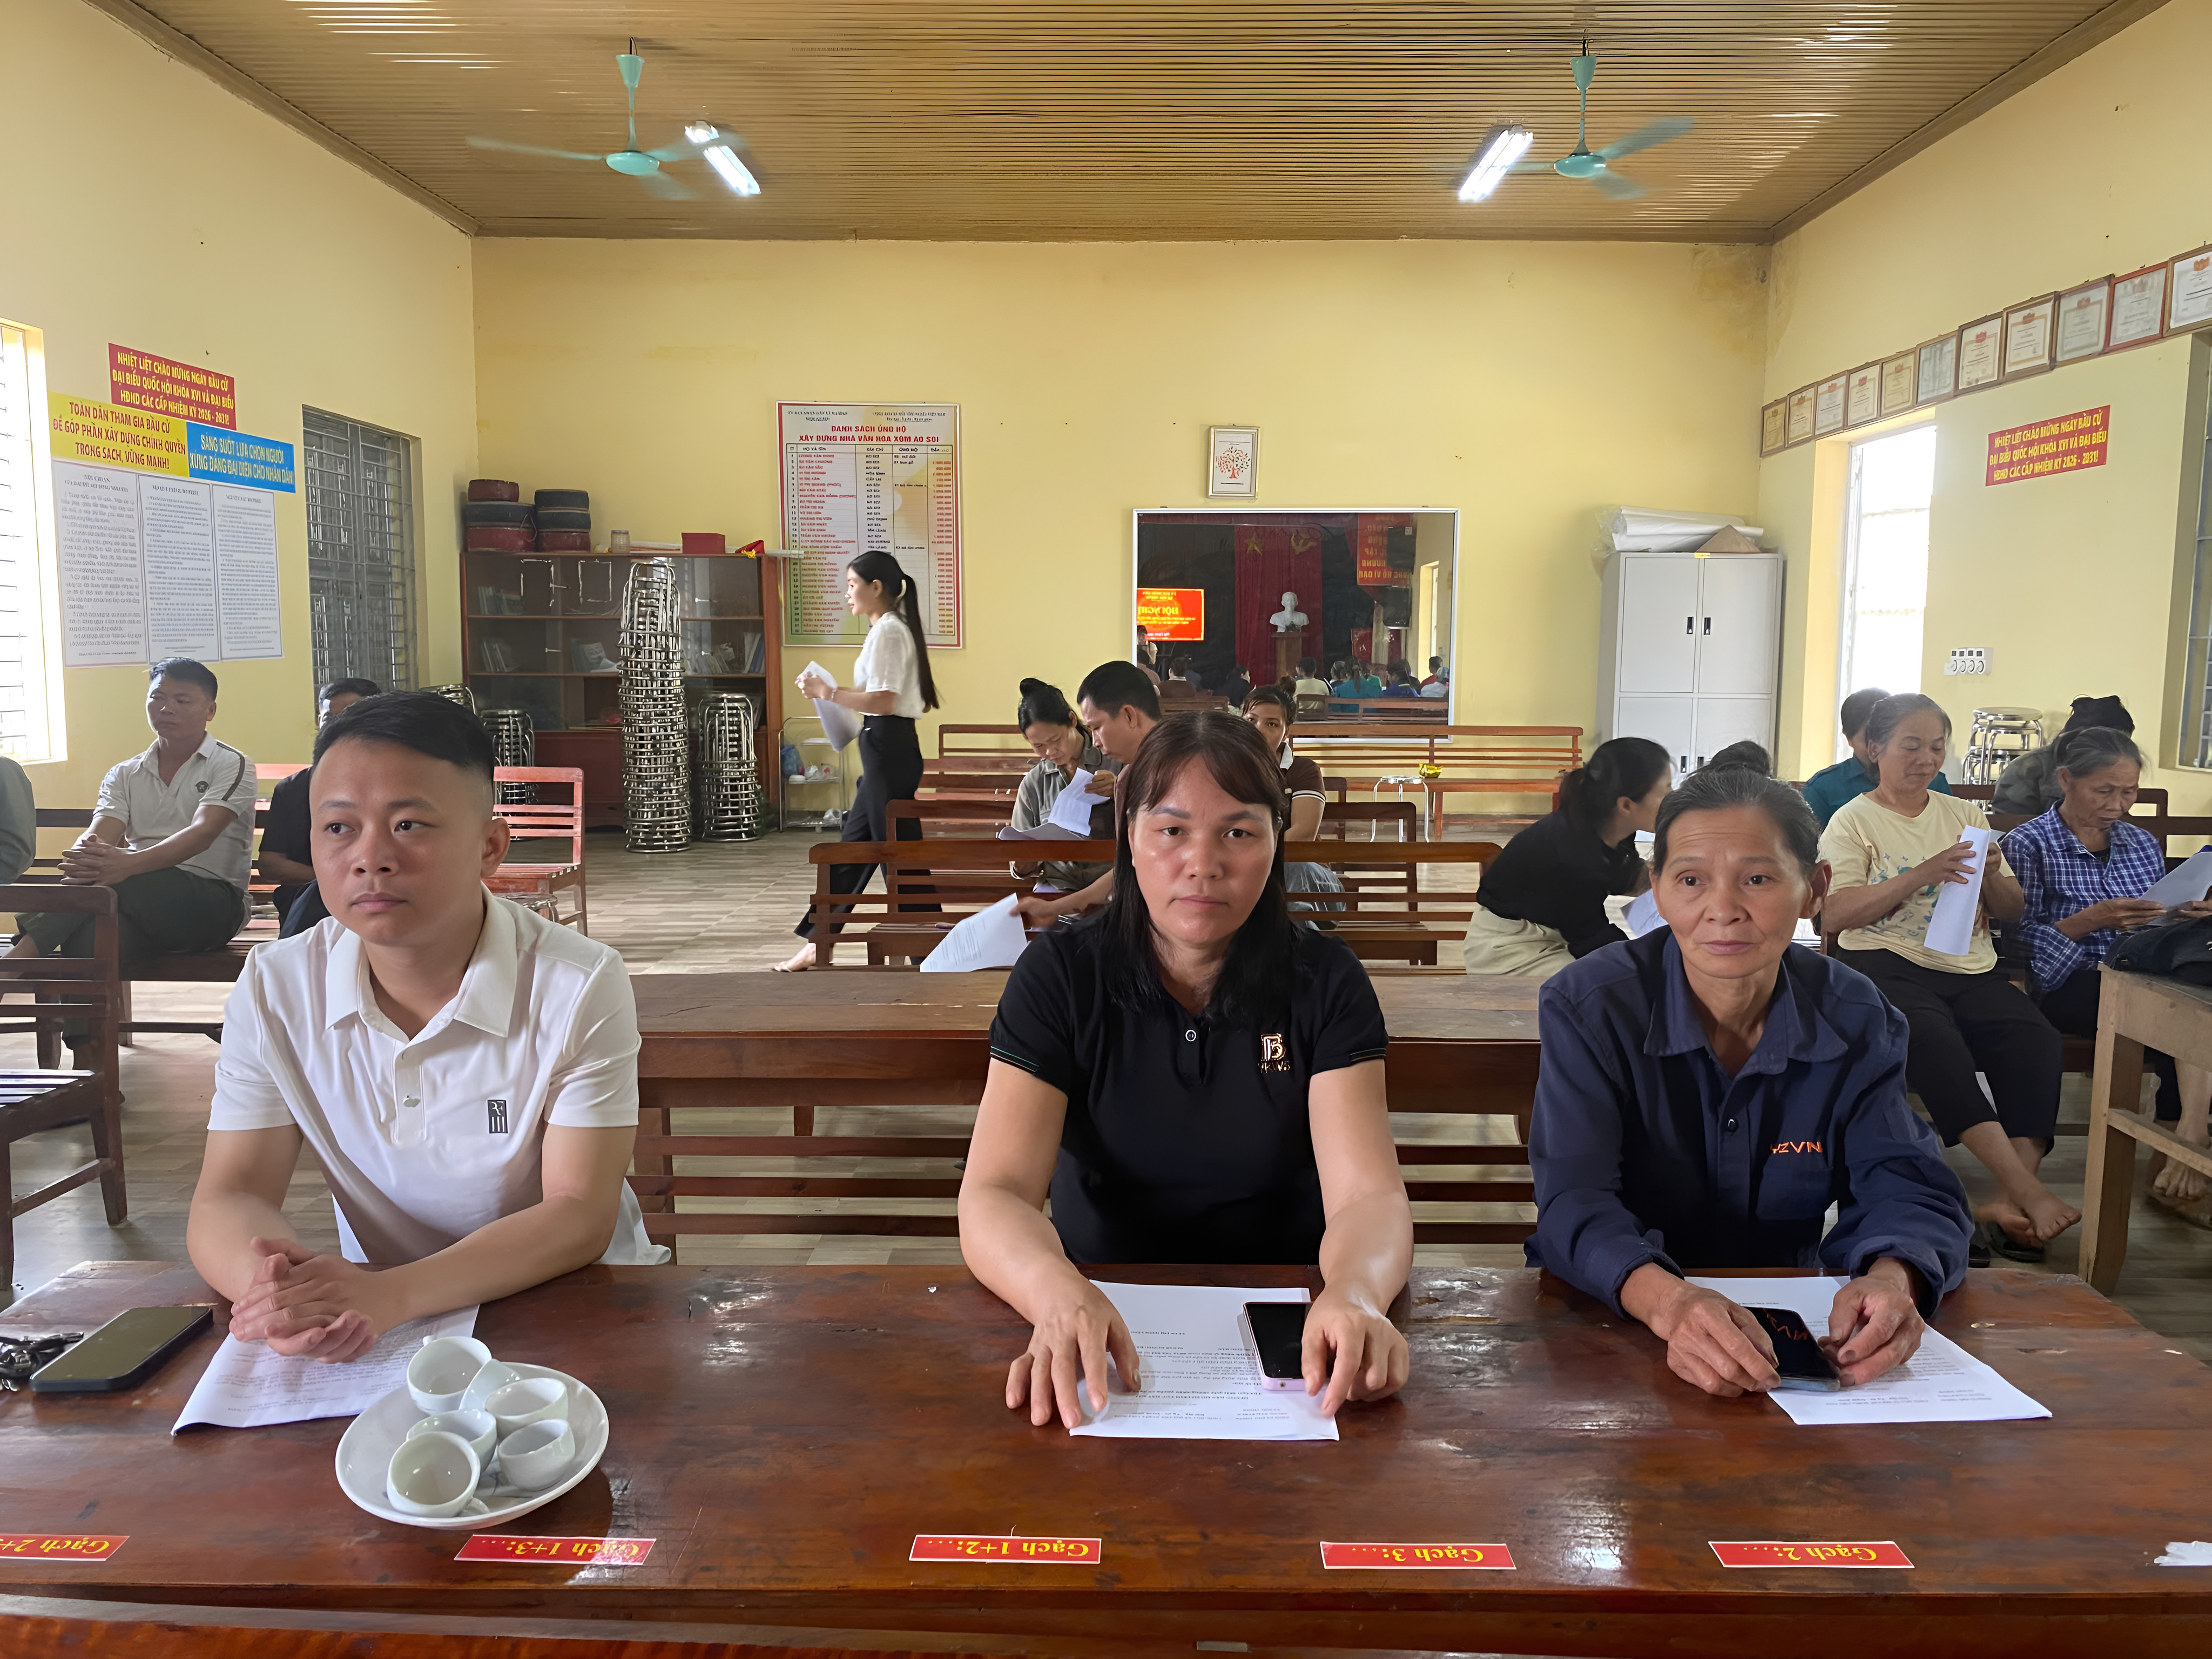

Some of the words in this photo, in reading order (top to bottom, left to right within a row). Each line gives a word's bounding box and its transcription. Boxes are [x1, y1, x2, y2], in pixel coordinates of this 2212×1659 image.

[118, 352, 137, 370] NHIỆT
[139, 356, 152, 374] LIỆT
[172, 365, 190, 382] MỪNG
[191, 370, 206, 387] NGÀY
[208, 373, 219, 391] BẦU
[221, 376, 228, 391] CỬ
[112, 369, 124, 386] ĐẠI
[143, 376, 160, 390] QUỐC
[161, 379, 172, 396] HỘI
[191, 389, 200, 401] XVI
[202, 390, 210, 404] VÀ
[211, 394, 221, 409] ĐẠI
[221, 394, 234, 409] BIỂU
[70, 401, 90, 418] TOÀN
[93, 405, 109, 422] DÂN
[110, 410, 131, 426] THAM
[133, 416, 144, 429] GIA
[147, 415, 159, 431] BẦU
[161, 419, 170, 434] CỬ
[121, 390, 139, 404] HĐND
[155, 395, 167, 412] CẤP
[168, 400, 188, 417] NHIỆM
[189, 403, 197, 418] KỲ
[198, 407, 211, 420] 2026
[65, 419, 79, 434] GÓP
[82, 421, 102, 440] PHẦN
[120, 431, 140, 447] DỰNG
[142, 434, 163, 450] CHÍNH
[165, 439, 185, 455] QUYỀN
[896, 426, 906, 434] HỘ
[2040, 422, 2059, 437] MỪNG
[2060, 417, 2078, 433] NGÀY
[2078, 413, 2091, 429] BẦU
[2093, 409, 2103, 425] CỬ
[75, 442, 100, 458] TRONG
[103, 448, 123, 463] SẠCH,
[125, 449, 144, 466] VỮNG
[147, 455, 169, 470] MẠNH!
[201, 432, 218, 452] SÁNG
[2028, 442, 2039, 459] HỘI
[2070, 433, 2078, 448] VÀ
[2079, 434, 2090, 448] ĐẠI
[2092, 427, 2107, 444] BIỂU
[190, 449, 208, 470] XỨNG
[227, 460, 238, 478] ĐẠI
[2021, 460, 2033, 476] CẤP
[40, 1537, 110, 1554] Gạch
[1022, 1540, 1089, 1557] Gạch
[1414, 1546, 1483, 1563] Gạch
[1804, 1544, 1877, 1562] Gạch
